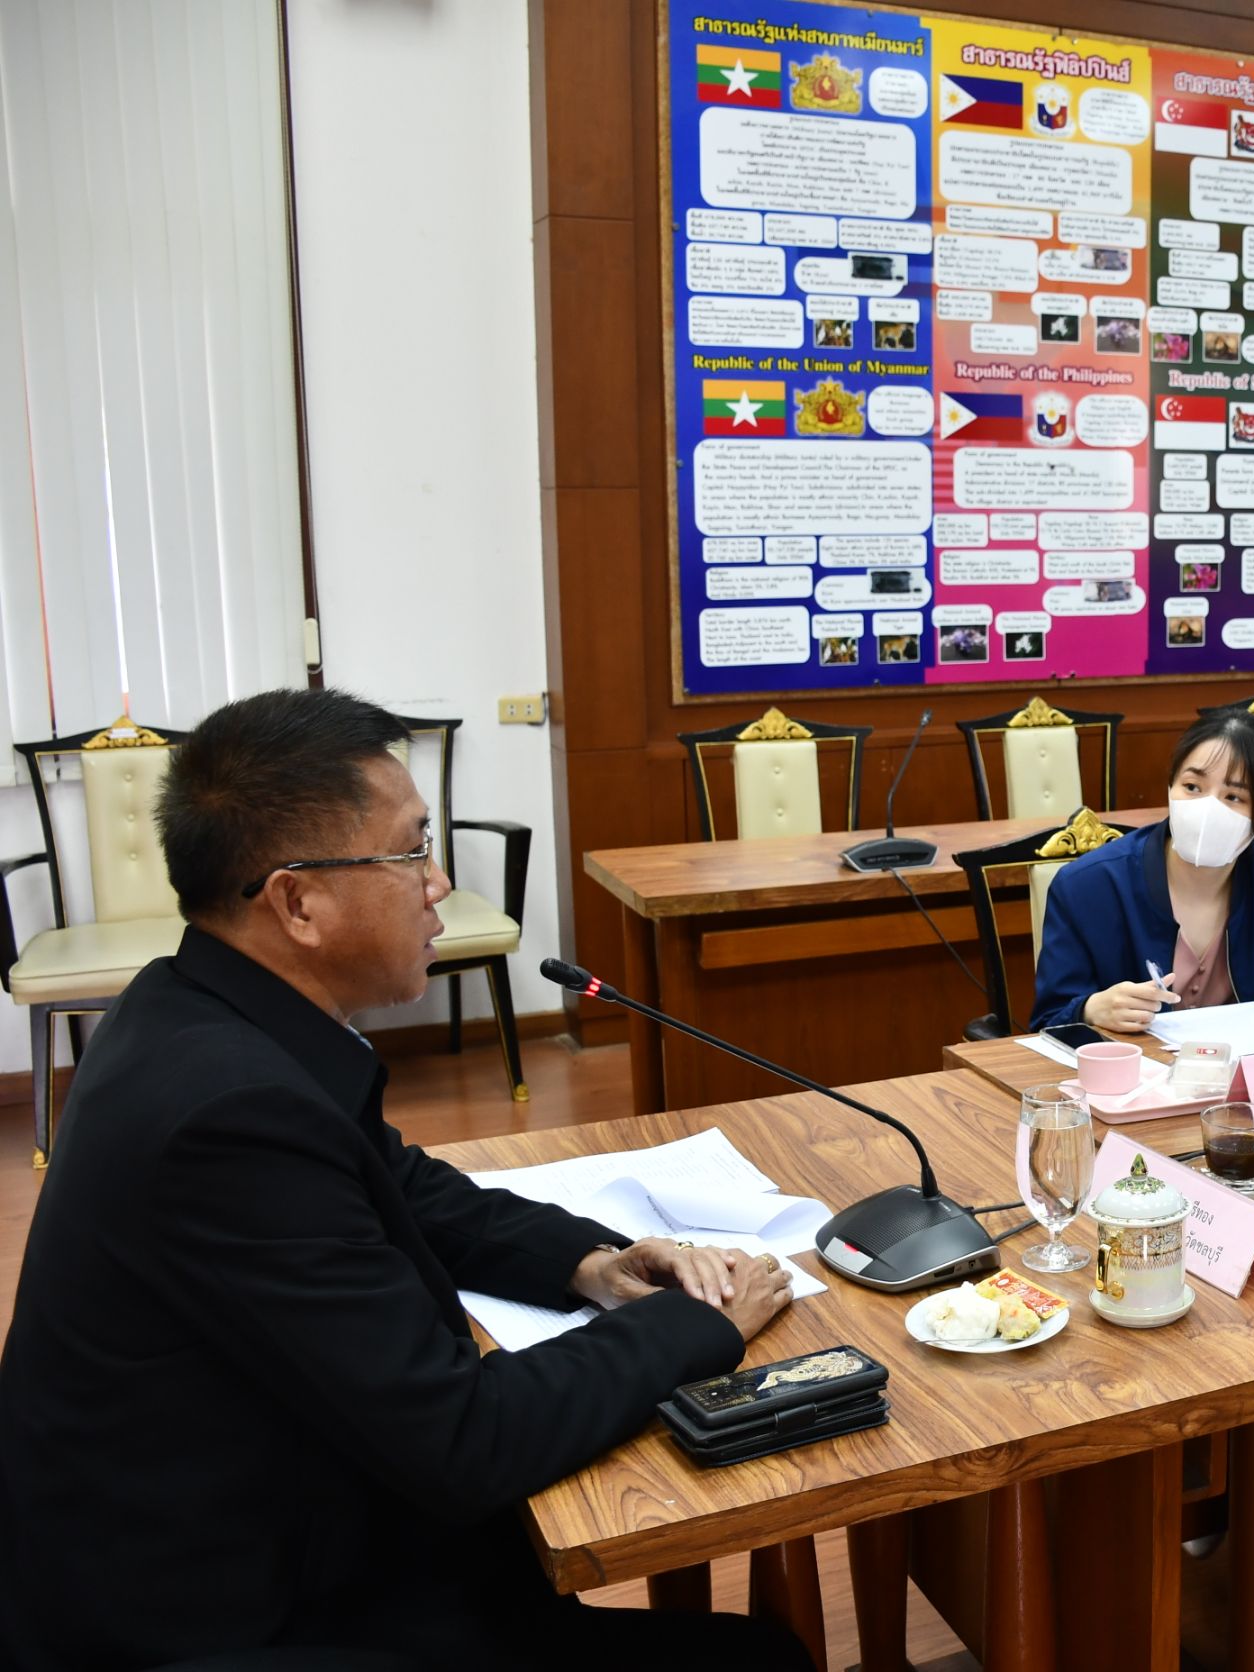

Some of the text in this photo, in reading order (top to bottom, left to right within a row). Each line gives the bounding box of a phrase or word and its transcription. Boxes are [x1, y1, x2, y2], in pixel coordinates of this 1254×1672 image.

[694, 16, 924, 56] สาธารณรัฐแห่งสหภาพเมียนมาร์
[962, 45, 1131, 83] สาธารณรัฐฟิลิปปินส์
[693, 355, 929, 377] Republic of the Union of Myanmar
[955, 363, 1133, 385] Republic of the Philippines
[1168, 370, 1231, 391] Republic
[1233, 373, 1249, 390] of
